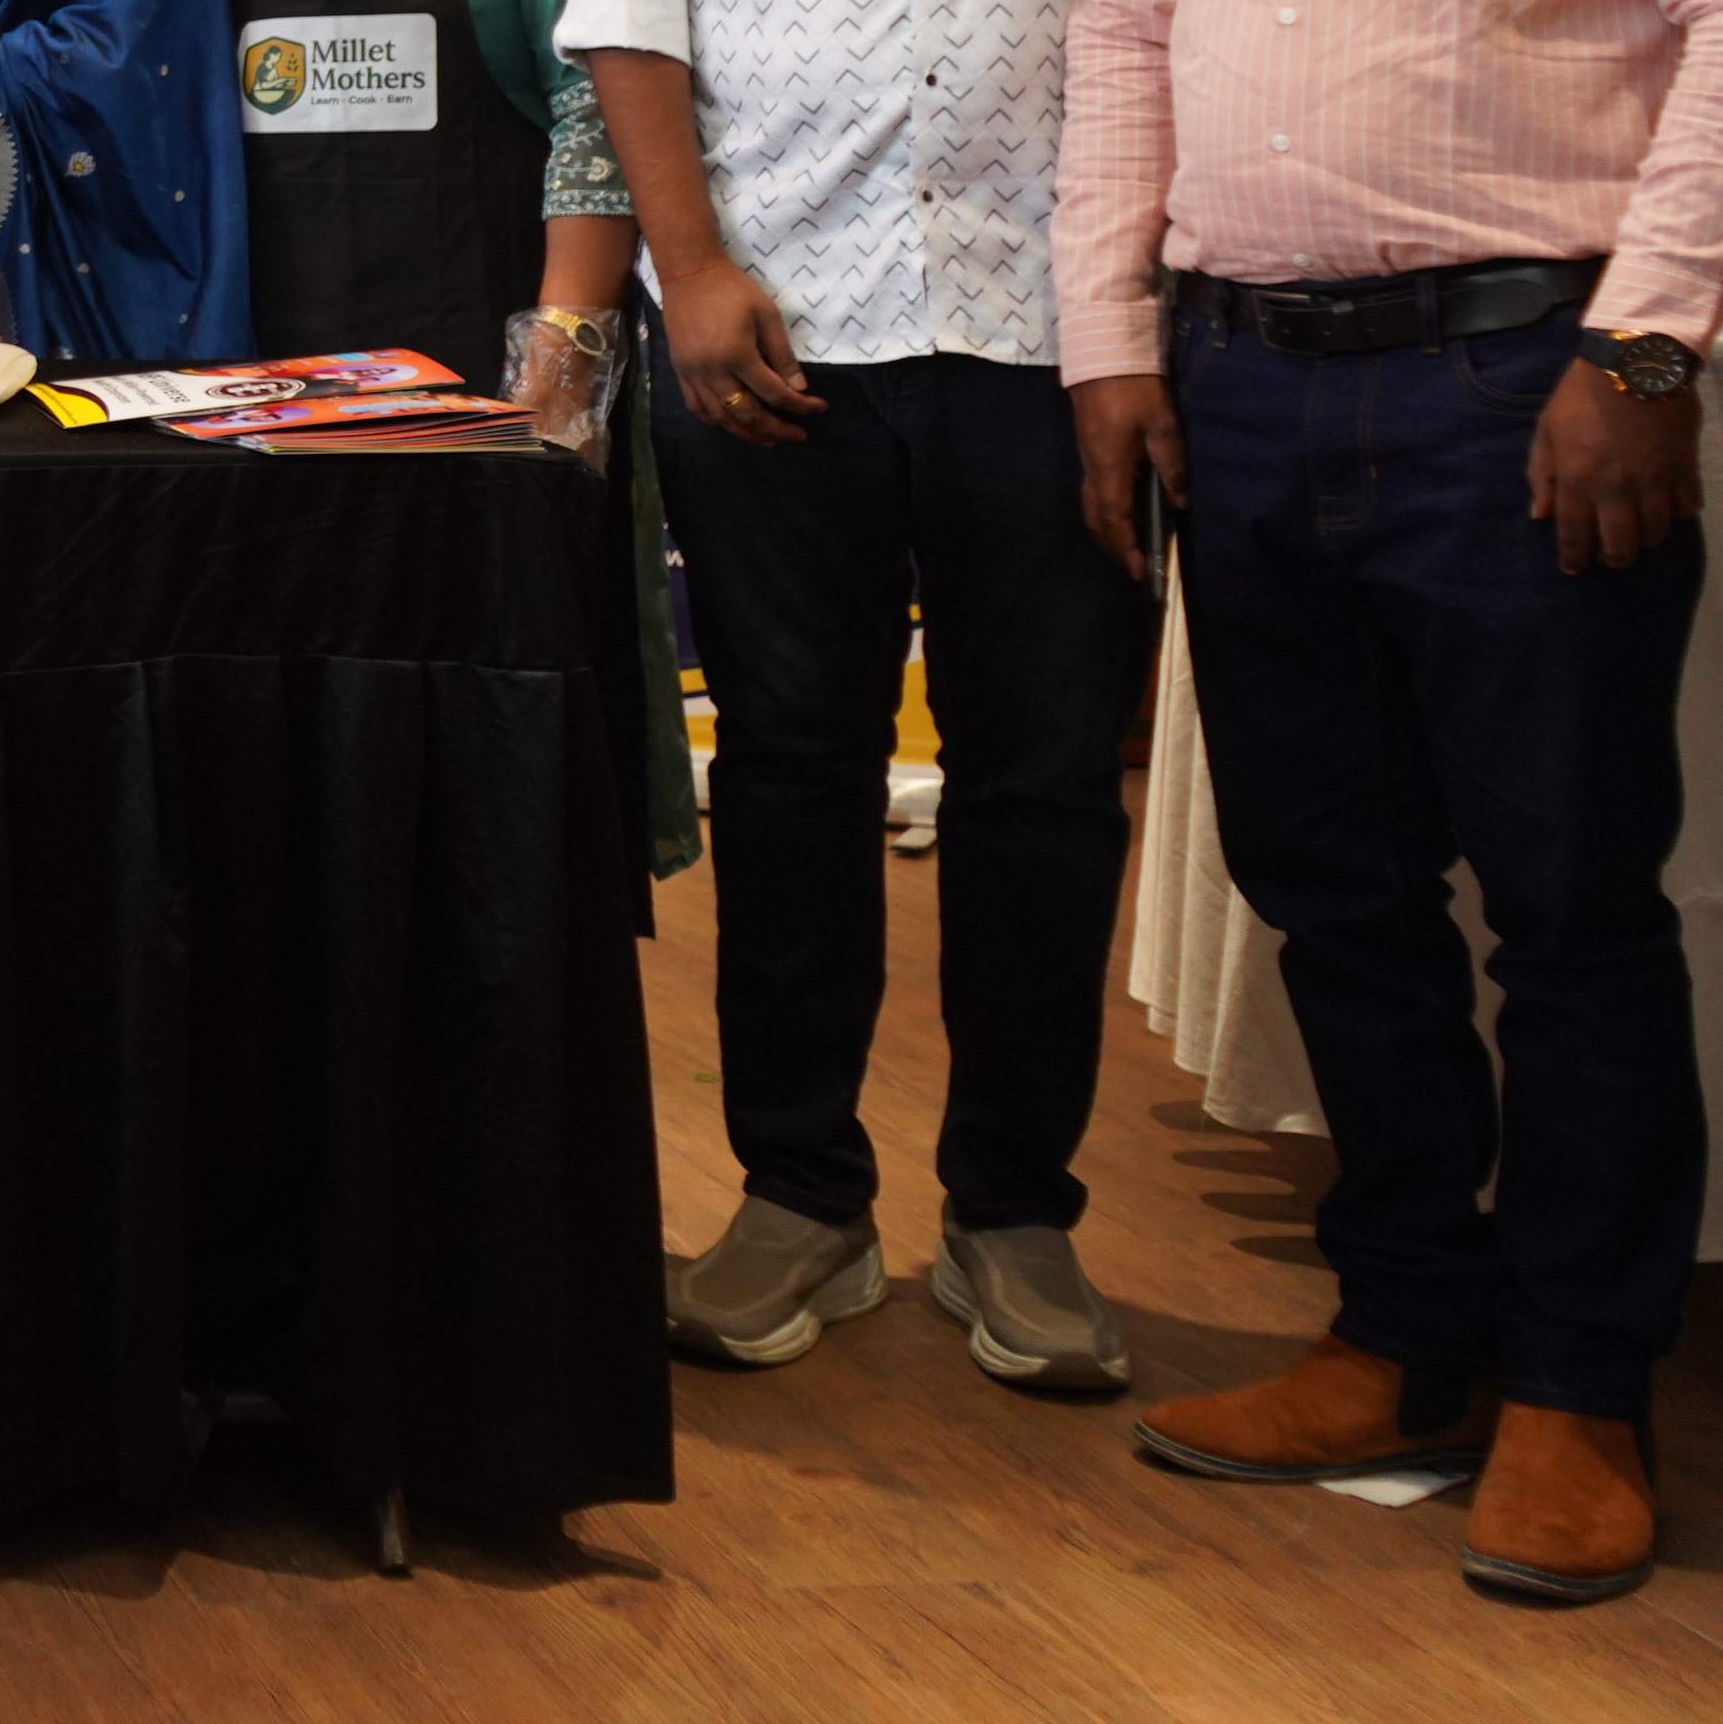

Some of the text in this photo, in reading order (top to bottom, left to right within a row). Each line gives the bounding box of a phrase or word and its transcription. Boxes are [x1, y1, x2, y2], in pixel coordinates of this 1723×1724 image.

[311, 37, 397, 64] Millet
[311, 66, 427, 91] Mothers
[310, 93, 414, 106] Learn Cook Earn
